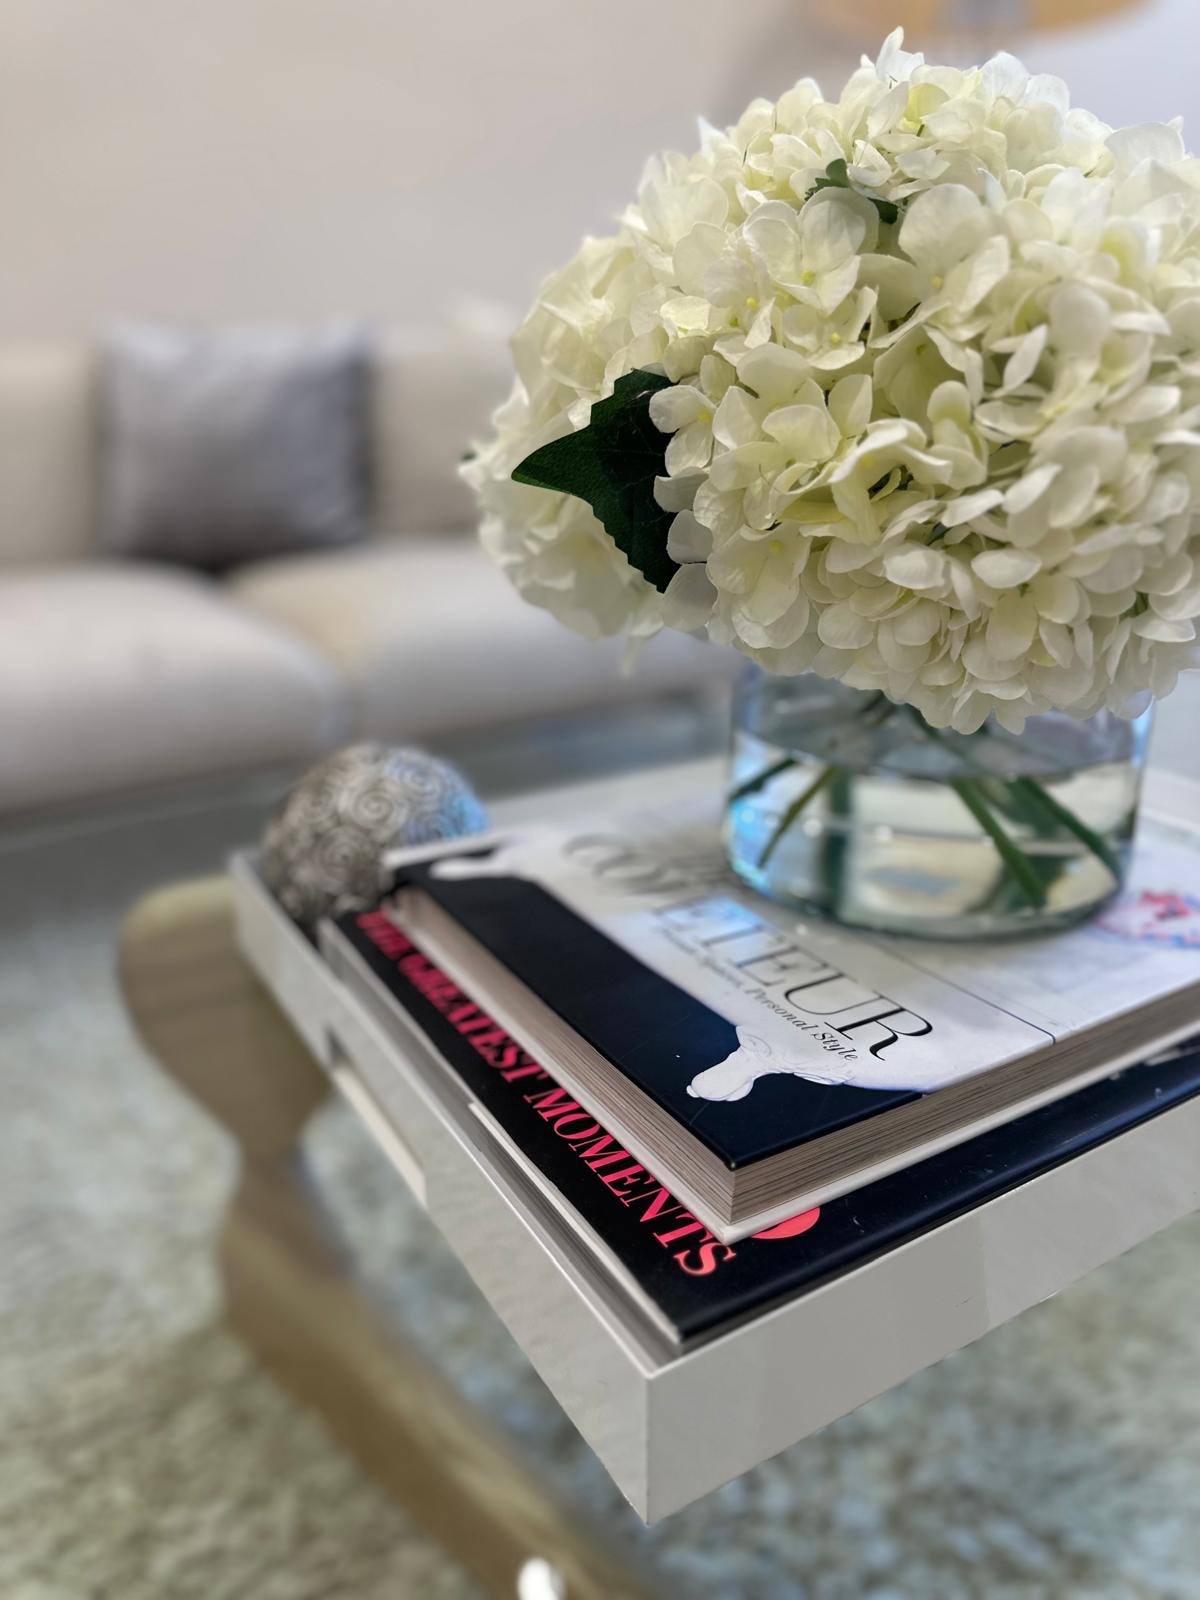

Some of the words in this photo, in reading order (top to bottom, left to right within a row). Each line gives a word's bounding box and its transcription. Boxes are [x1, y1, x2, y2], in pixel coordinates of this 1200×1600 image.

[745, 987, 818, 1031] Personal
[812, 1029, 859, 1062] Style
[523, 1087, 737, 1276] MOMENTS
